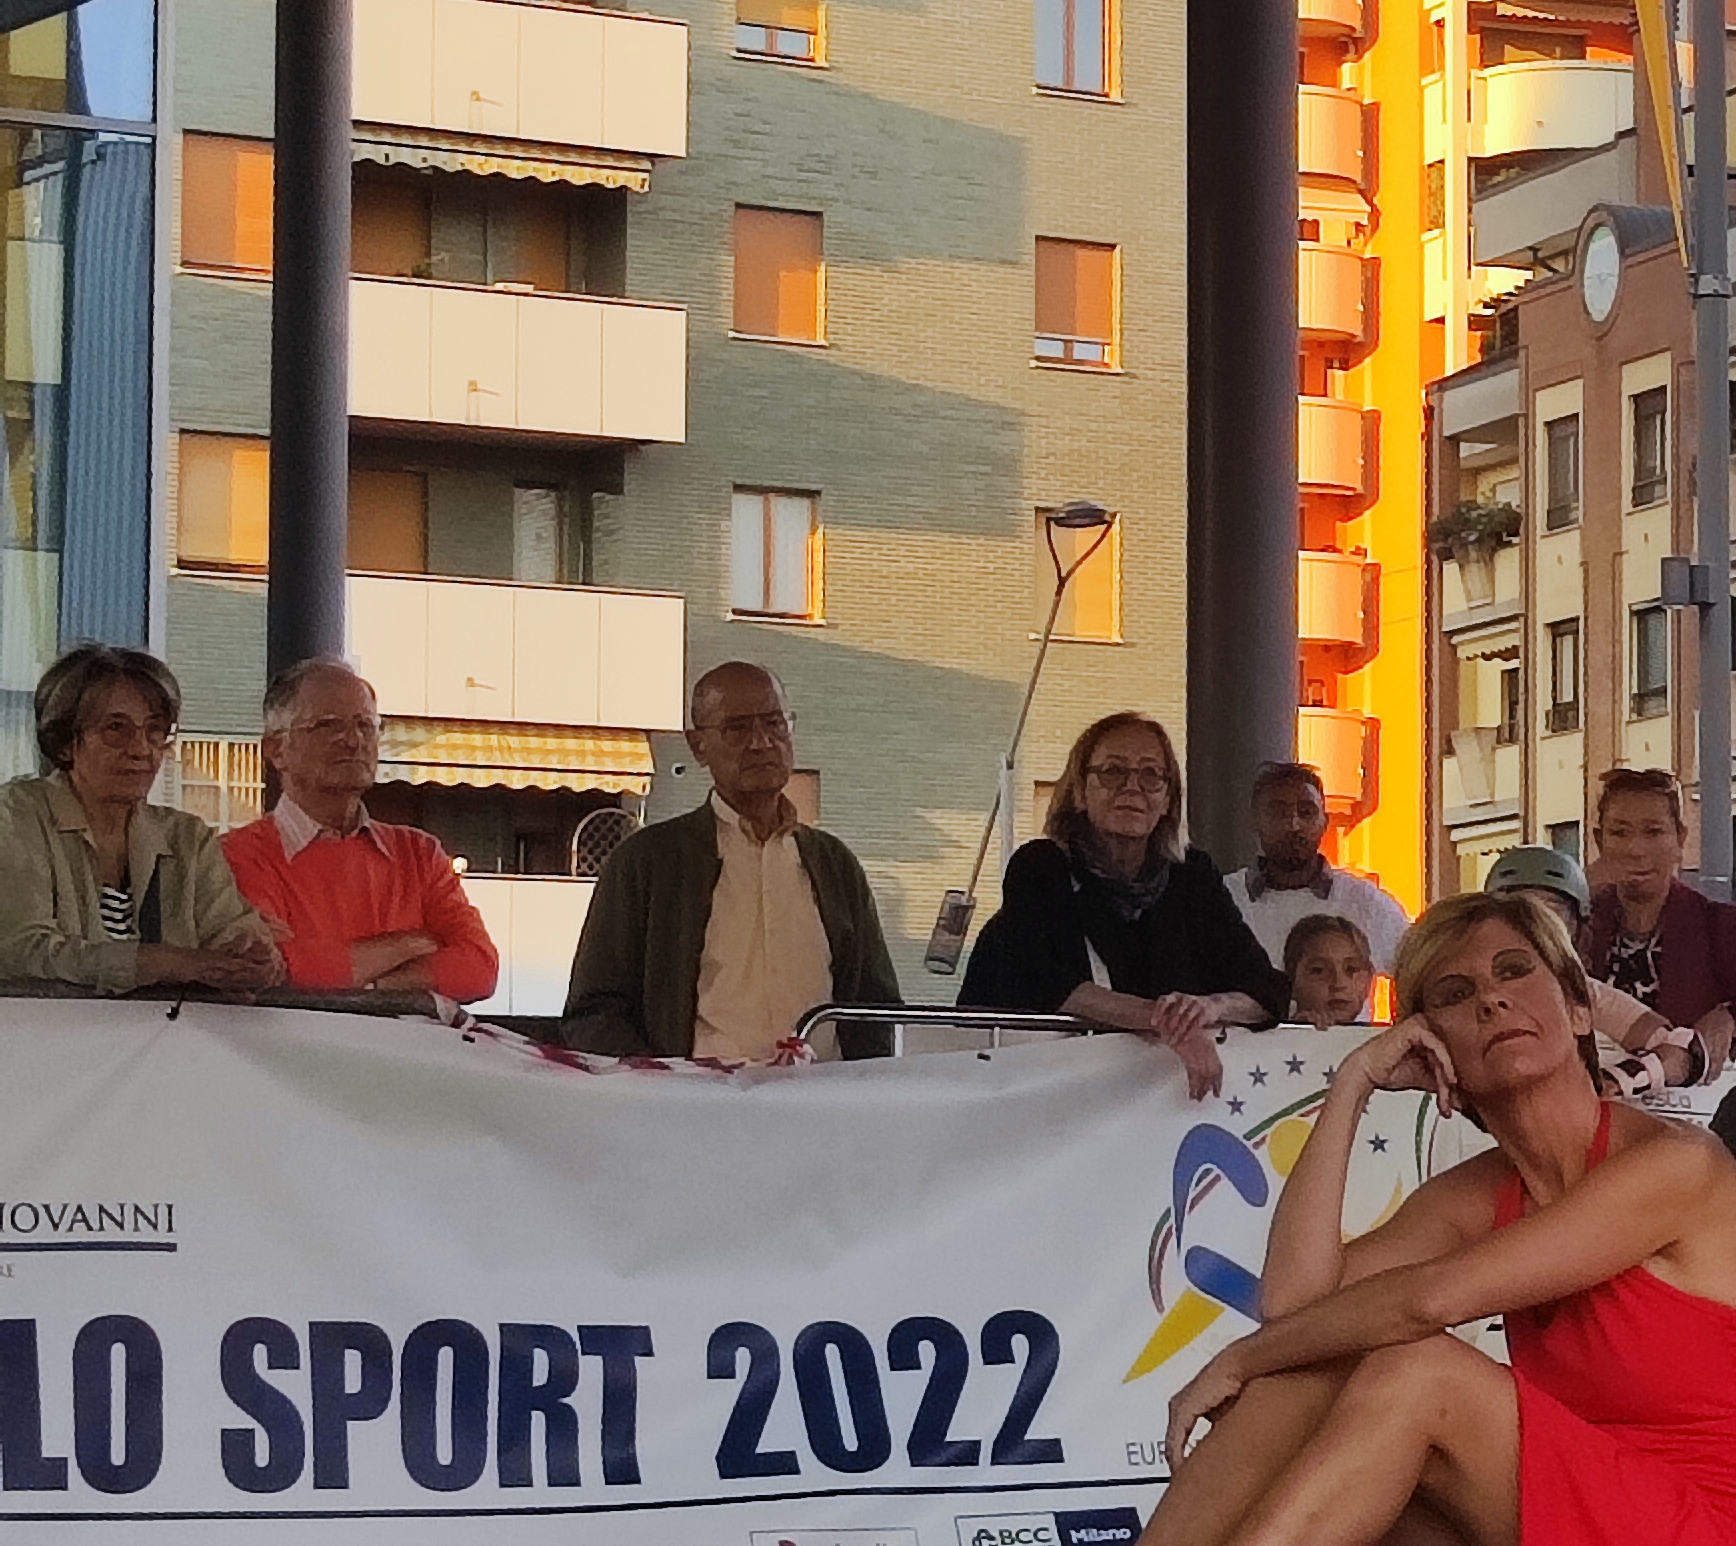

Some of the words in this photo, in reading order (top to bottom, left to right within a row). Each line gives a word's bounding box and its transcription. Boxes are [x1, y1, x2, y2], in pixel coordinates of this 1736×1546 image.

[220, 1316, 654, 1494] SPORT
[705, 1309, 1065, 1480] 2022
[999, 1527, 1053, 1546] BCC
[1070, 1528, 1132, 1544] Milano
